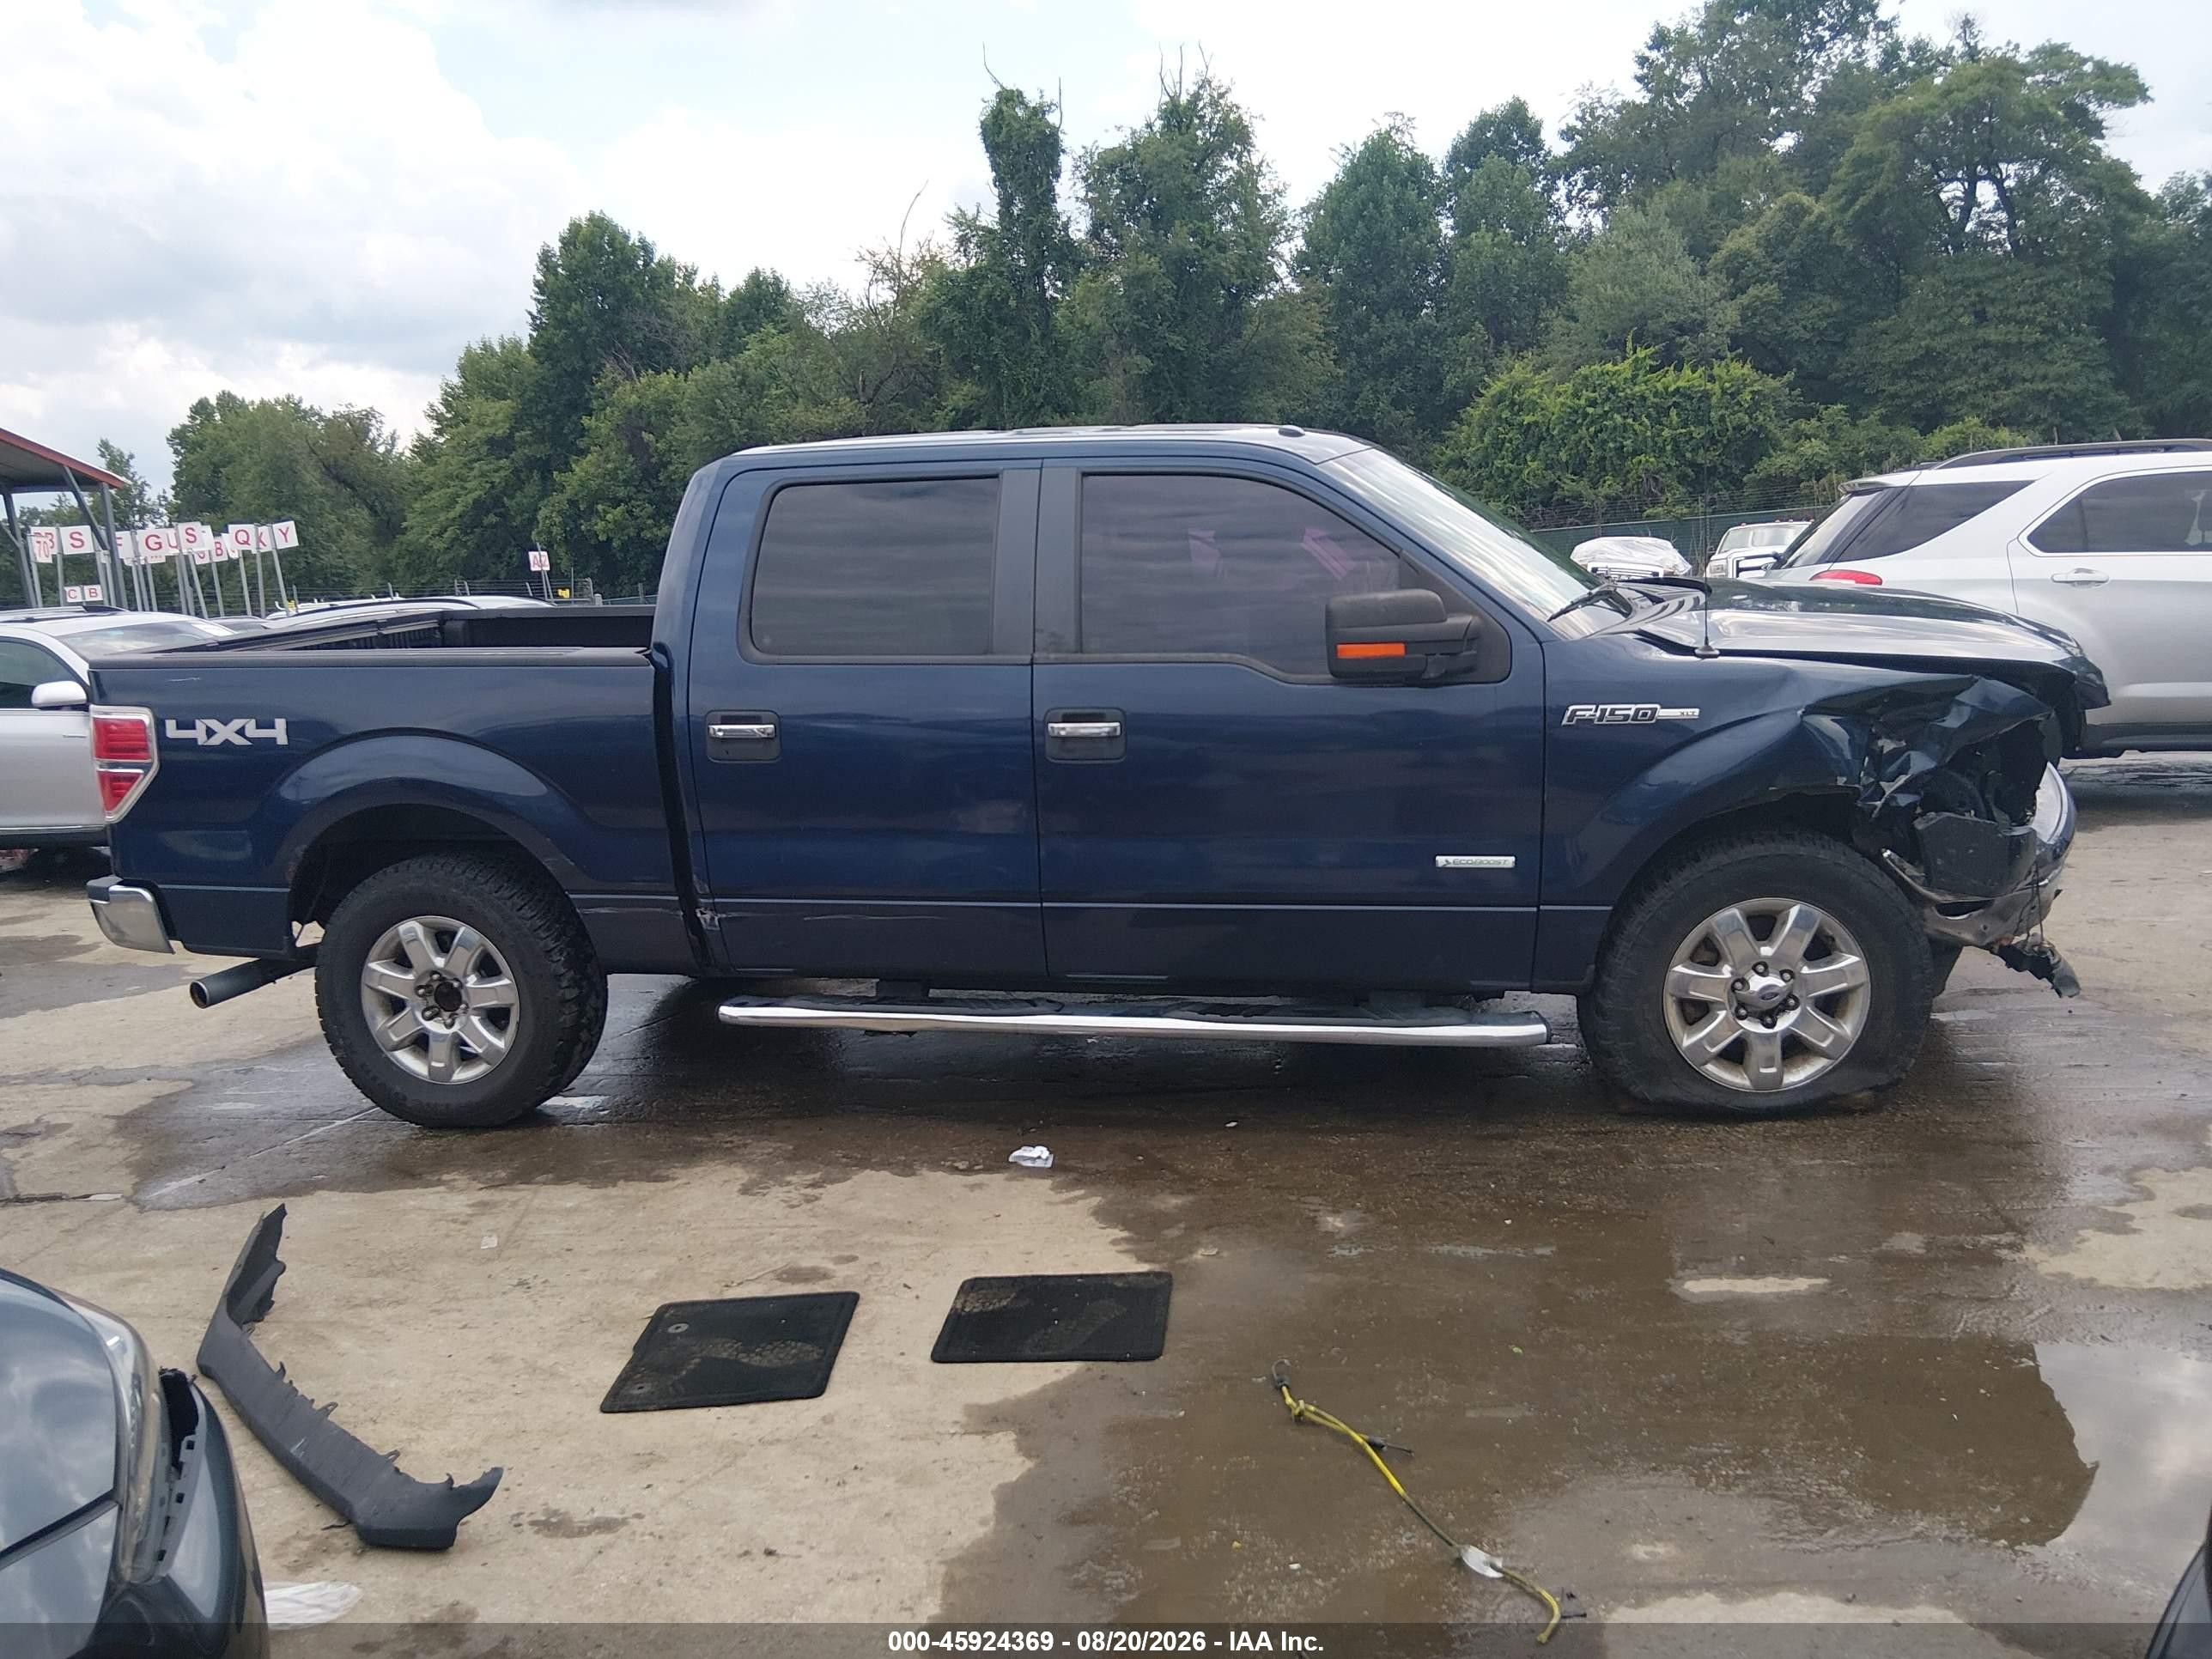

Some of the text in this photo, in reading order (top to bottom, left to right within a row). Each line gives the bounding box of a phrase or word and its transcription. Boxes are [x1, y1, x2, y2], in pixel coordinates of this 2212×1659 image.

[70, 531, 85, 549] S
[145, 534, 163, 551] G
[185, 527, 198, 544] S
[234, 529, 251, 546] Q
[278, 526, 289, 544] Y
[214, 541, 224, 557] B
[68, 589, 77, 599] C
[88, 587, 98, 599] B
[1561, 704, 1661, 726] F-150
